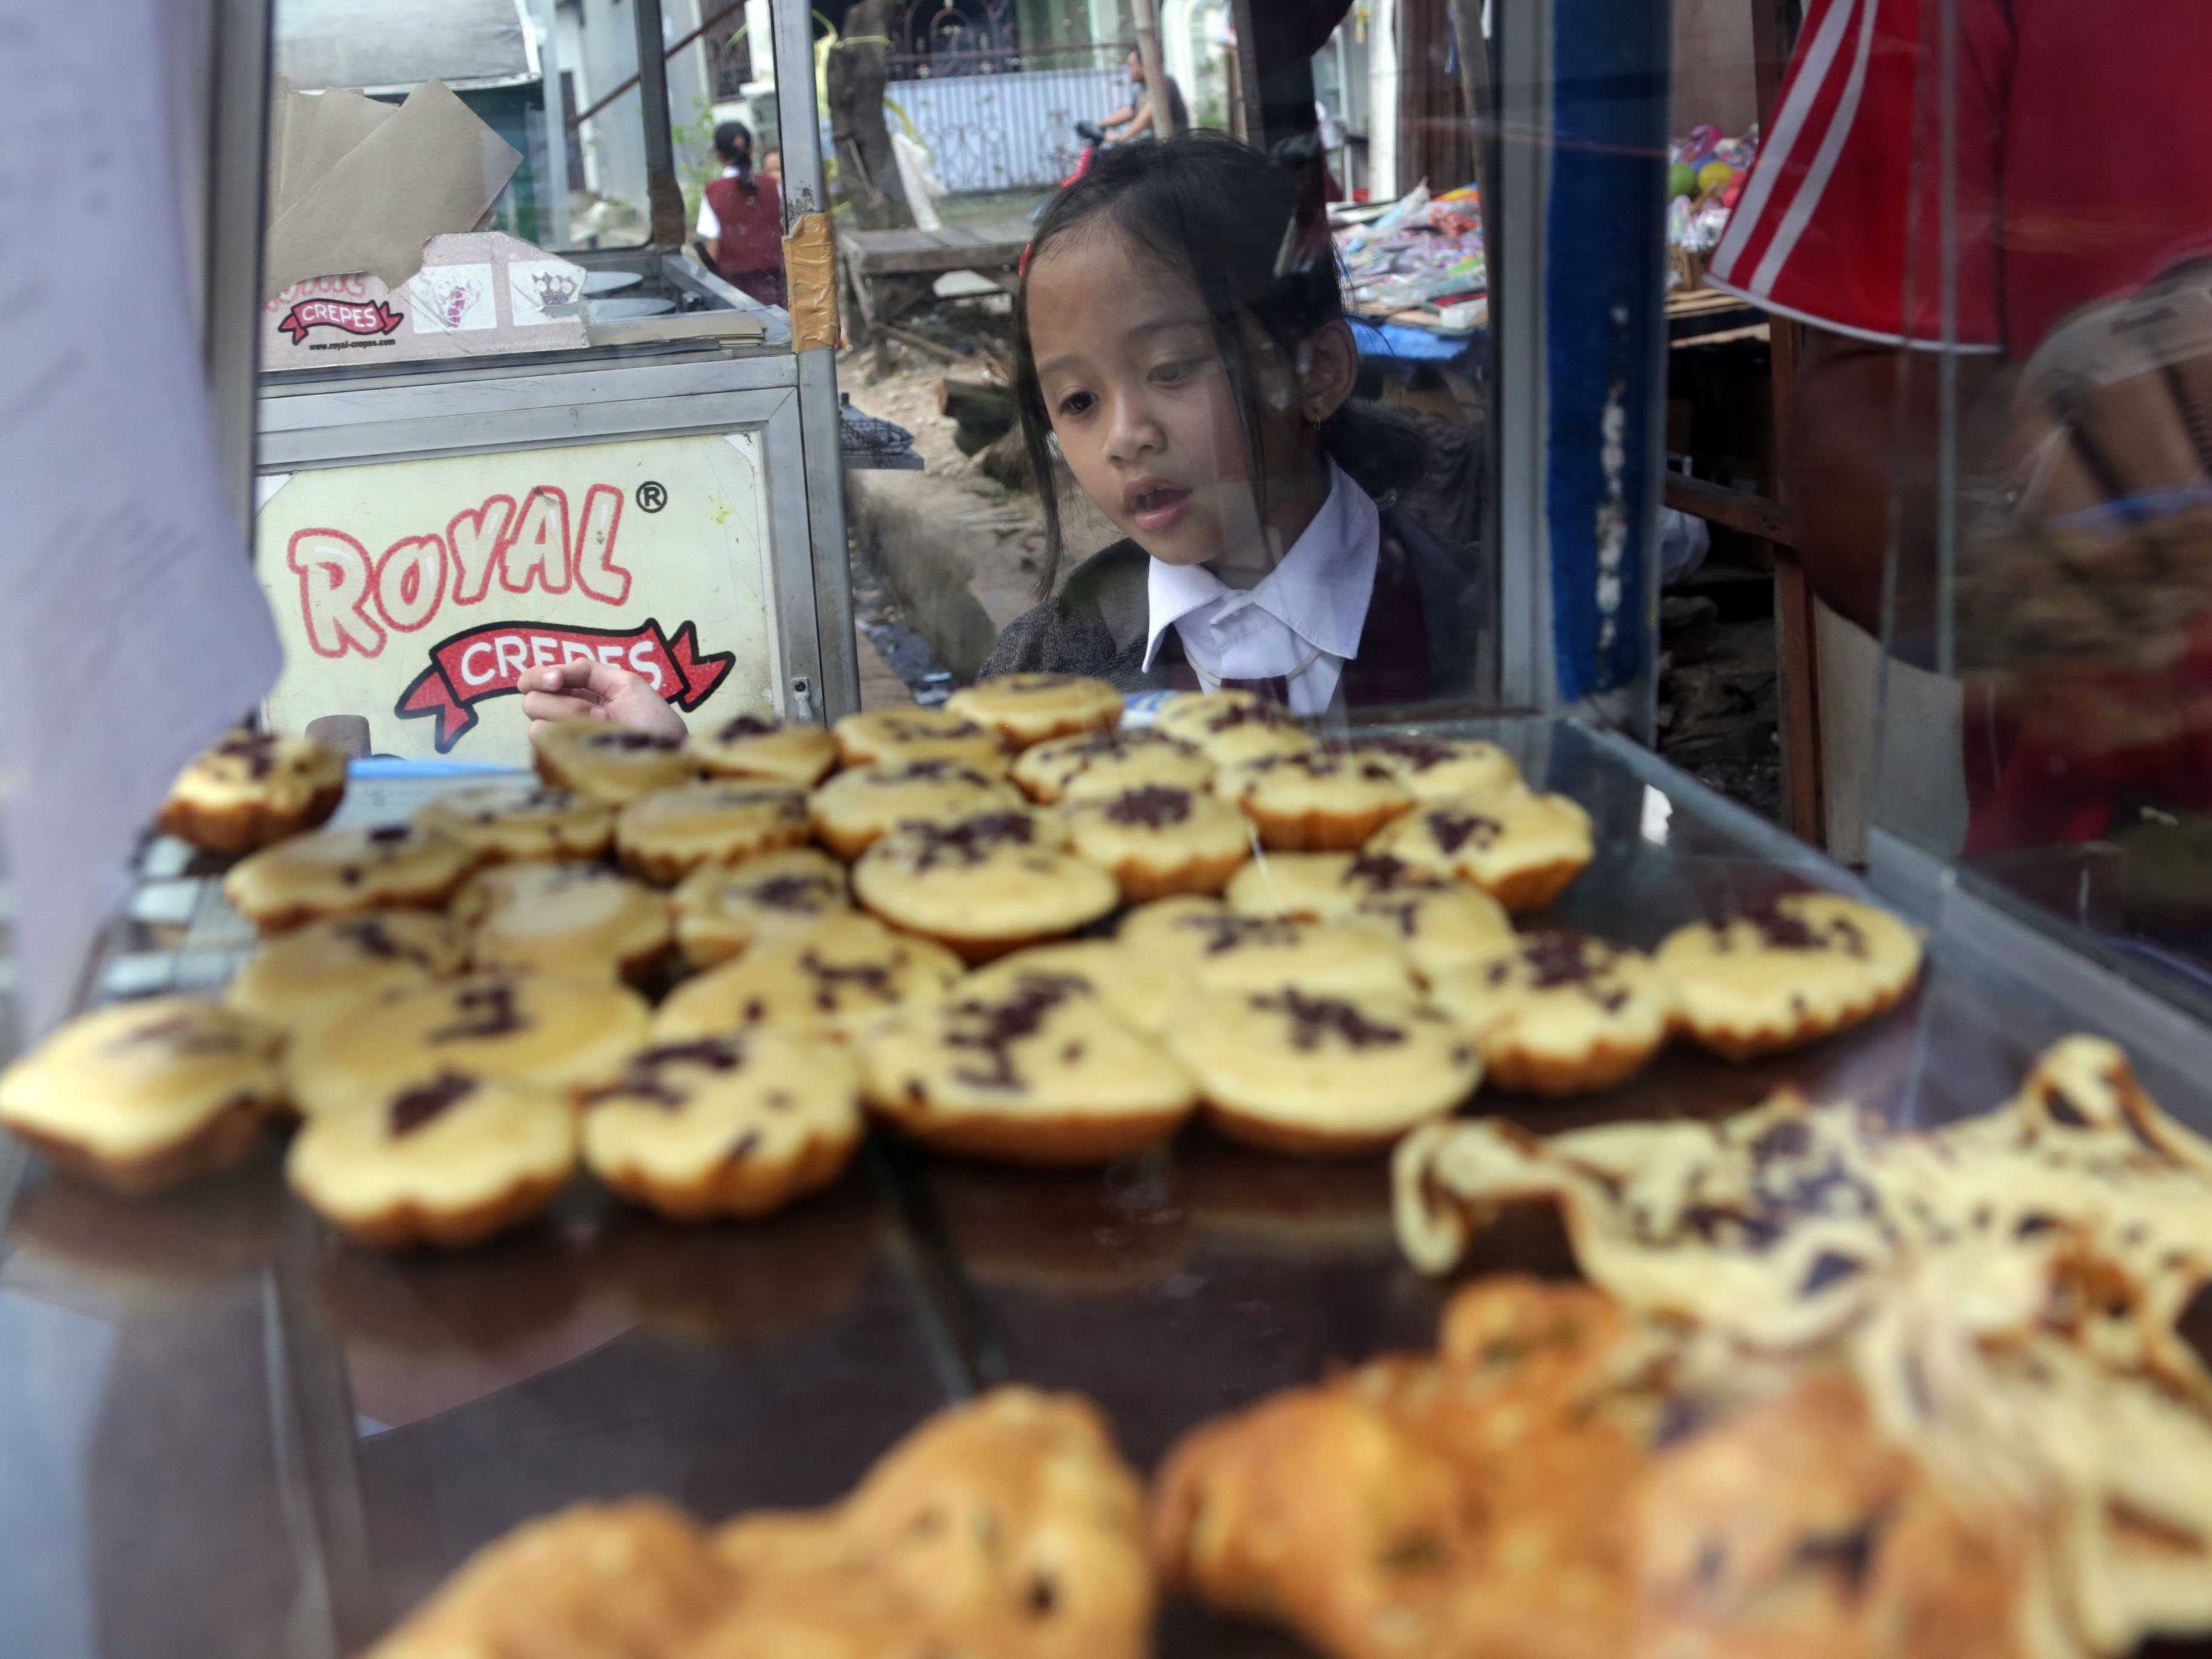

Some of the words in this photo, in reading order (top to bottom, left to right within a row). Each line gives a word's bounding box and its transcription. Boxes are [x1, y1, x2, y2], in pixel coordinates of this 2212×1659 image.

[303, 304, 377, 328] CREPES
[309, 338, 396, 351] www.royal-crepes.com
[287, 483, 633, 659] ROYAL
